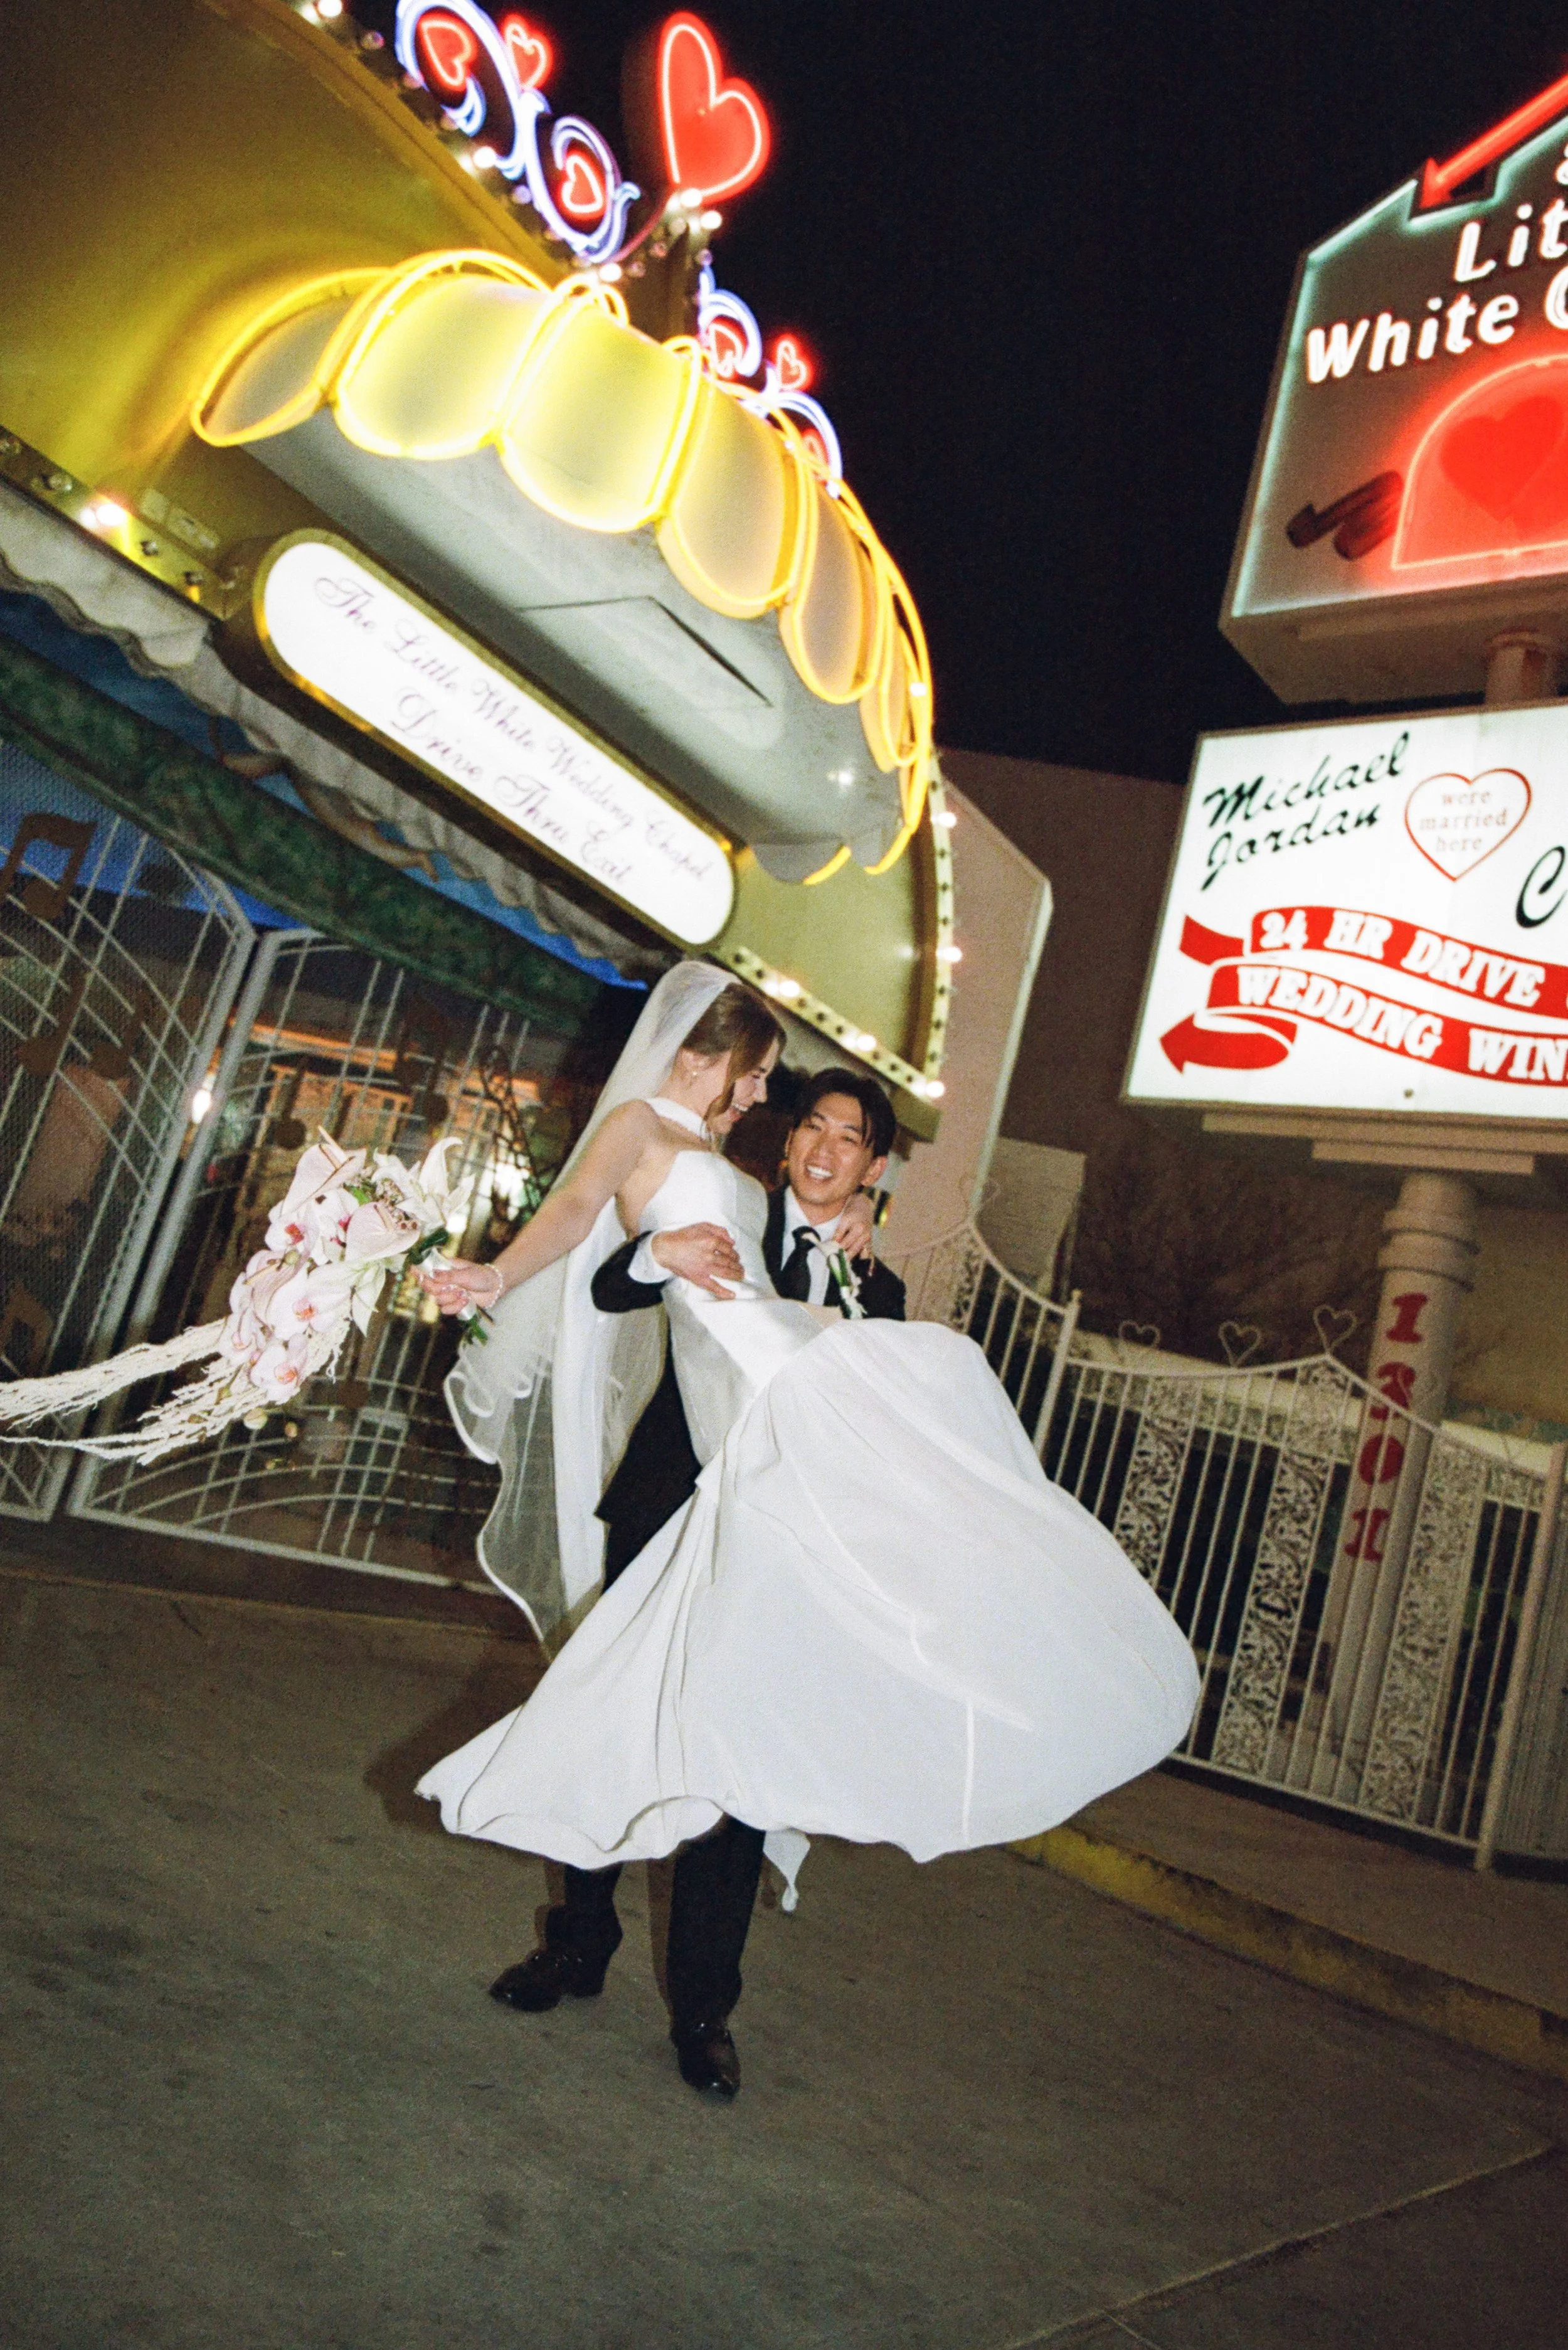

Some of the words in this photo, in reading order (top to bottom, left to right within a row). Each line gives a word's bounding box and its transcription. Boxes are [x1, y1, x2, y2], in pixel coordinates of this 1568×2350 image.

[1454, 198, 1568, 282] Lit
[1306, 294, 1518, 383] White
[314, 577, 375, 633] The
[384, 618, 459, 693] Little
[472, 678, 534, 748] White
[546, 736, 634, 832] Wedding
[645, 811, 714, 882] Chapel
[389, 686, 482, 780] Drive
[581, 820, 633, 883] Exit
[1202, 730, 1409, 829] Michael
[1419, 808, 1507, 831] married
[1443, 790, 1490, 806] were
[1200, 804, 1380, 891] Jordan
[1436, 836, 1482, 853] here
[1259, 909, 1308, 950] 24
[1323, 909, 1393, 959] HR
[1399, 930, 1545, 1008] DRIVE
[1237, 965, 1443, 1059] WEDDING
[1468, 1028, 1568, 1082] WIN
[1343, 1292, 1429, 1561] 1301
